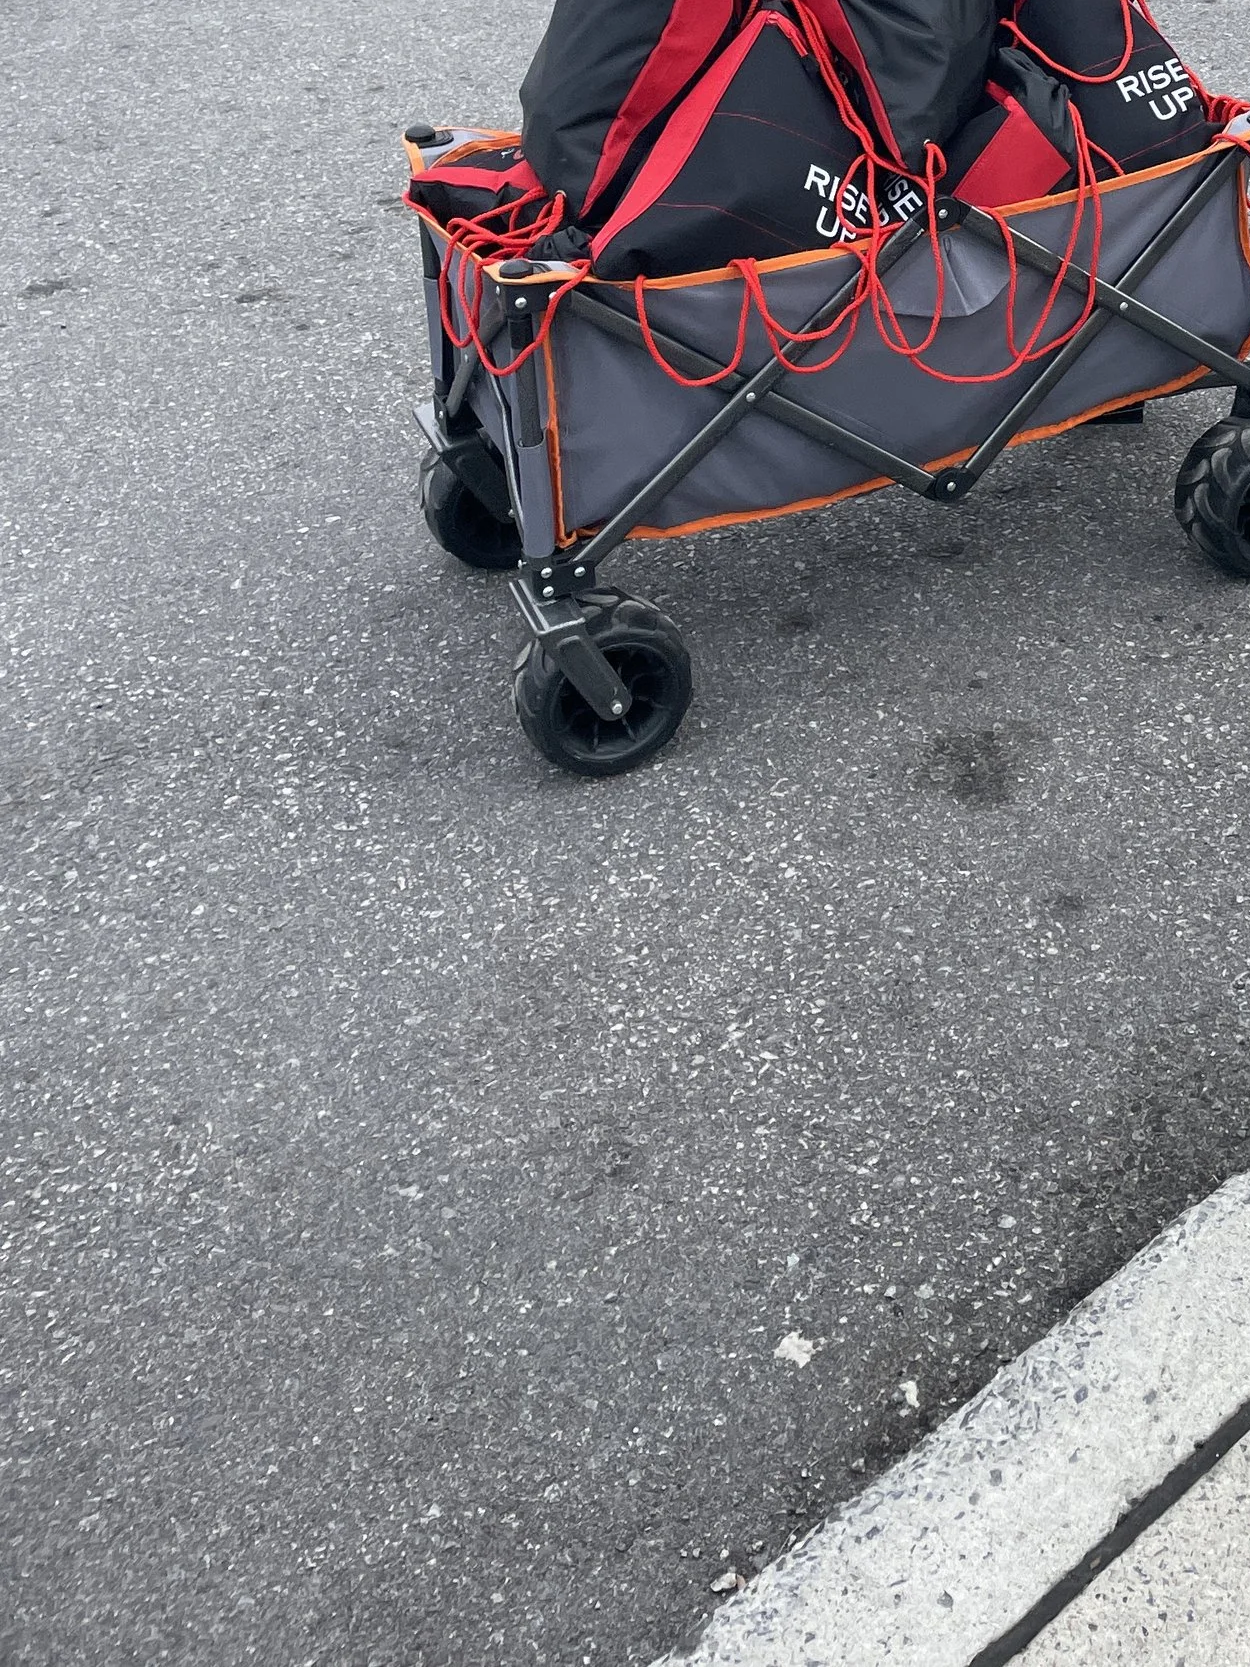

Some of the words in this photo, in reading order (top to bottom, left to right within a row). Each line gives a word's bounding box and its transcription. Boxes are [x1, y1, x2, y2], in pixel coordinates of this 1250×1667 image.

[1115, 57, 1189, 103] RISE
[1148, 86, 1194, 121] UP
[804, 163, 870, 225] RISE
